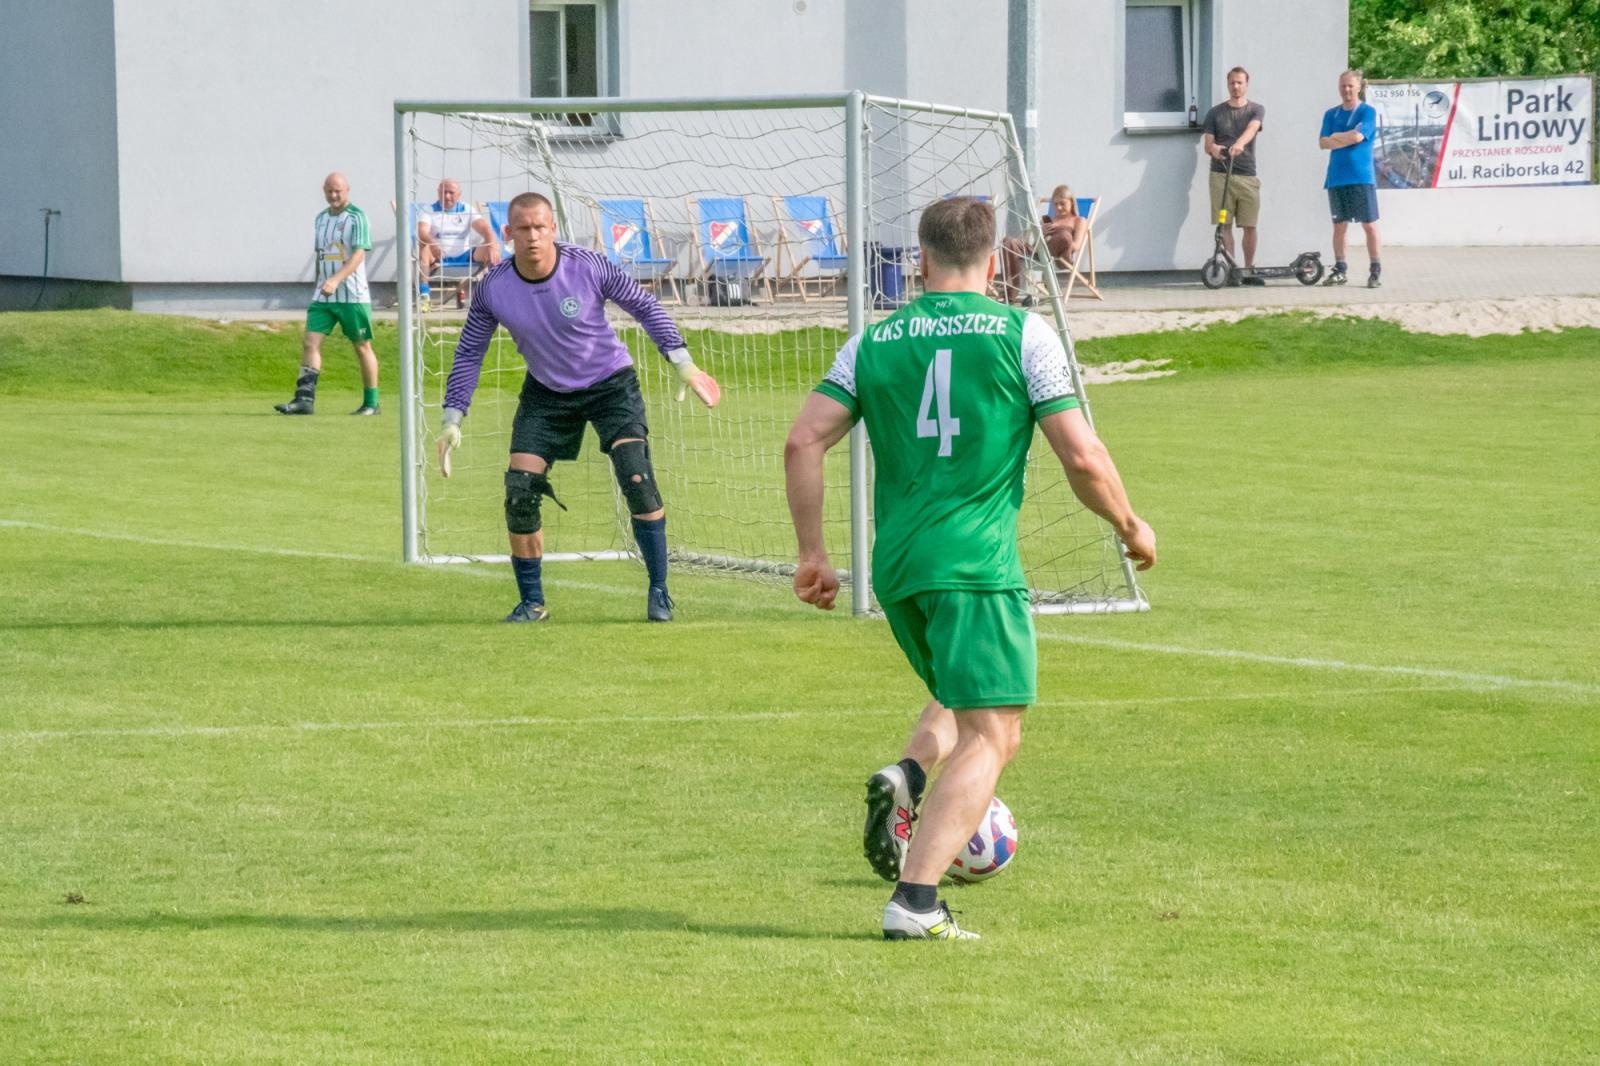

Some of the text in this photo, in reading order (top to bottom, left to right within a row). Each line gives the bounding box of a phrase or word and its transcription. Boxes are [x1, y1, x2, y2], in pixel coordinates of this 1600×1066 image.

[1374, 88, 1421, 98] 532 950 156
[1507, 85, 1573, 114] Park
[1478, 113, 1586, 145] Linowy
[1452, 148, 1512, 158] PRZYSTANEK
[1448, 160, 1584, 180] ul. Raciborska 42
[873, 313, 1008, 342] LKS OWSISZCZE
[916, 348, 960, 457] 4
